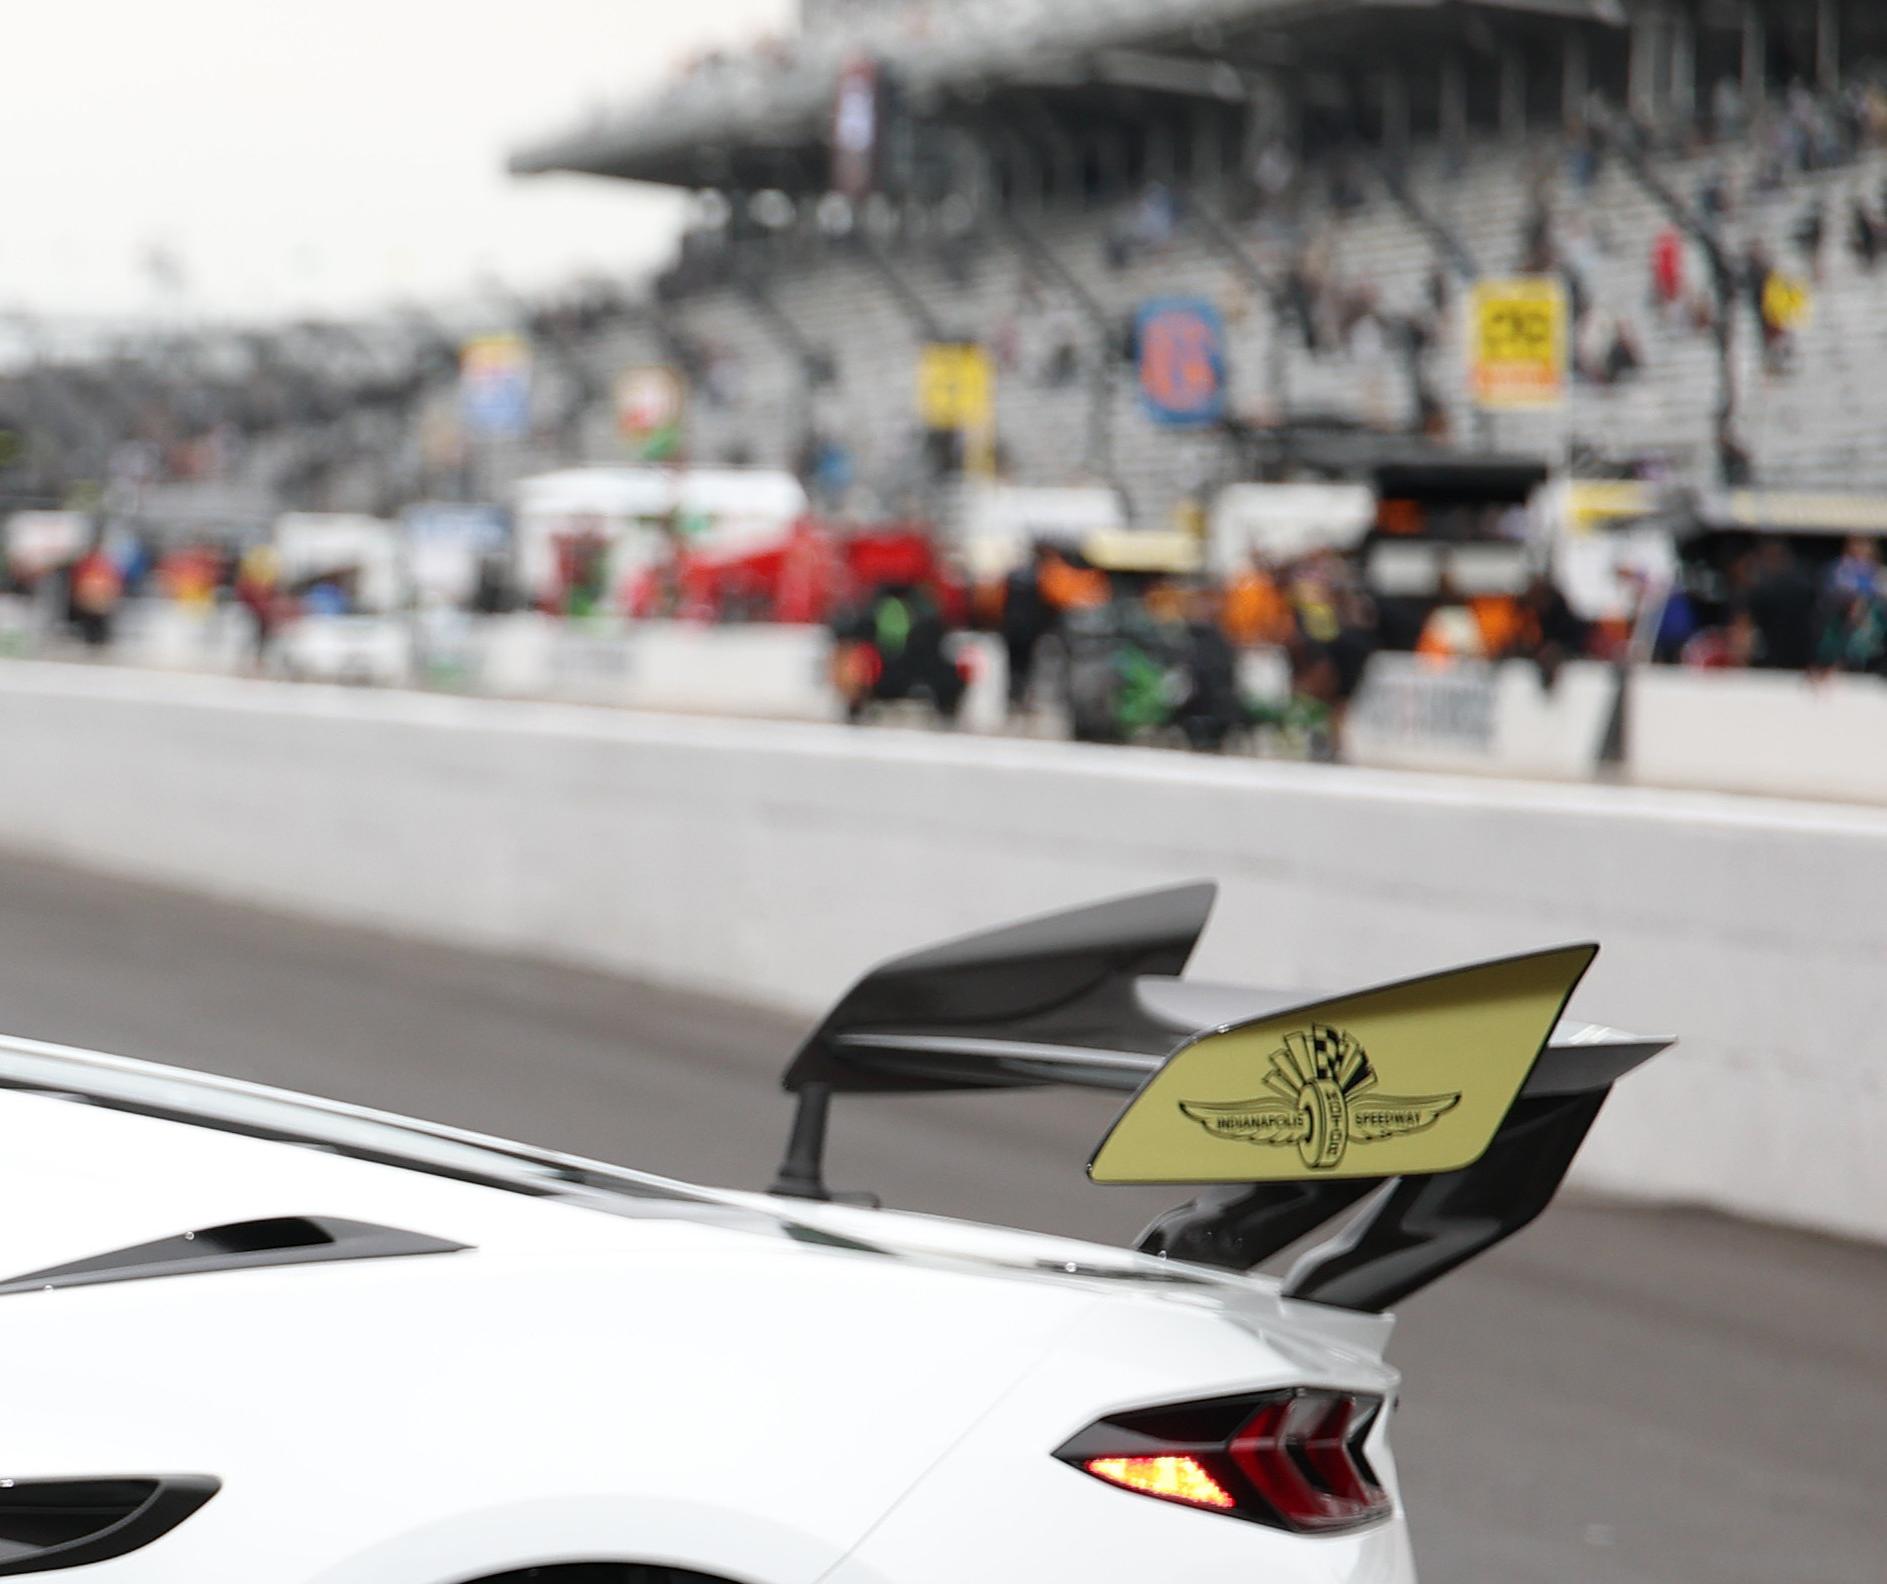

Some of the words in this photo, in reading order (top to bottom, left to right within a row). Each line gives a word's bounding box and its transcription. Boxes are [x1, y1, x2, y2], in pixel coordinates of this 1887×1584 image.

[1217, 1113, 1304, 1129] INDIANAPOLIS
[1326, 1091, 1343, 1156] MOTOR
[1355, 1110, 1421, 1125] SPEEDWAY
